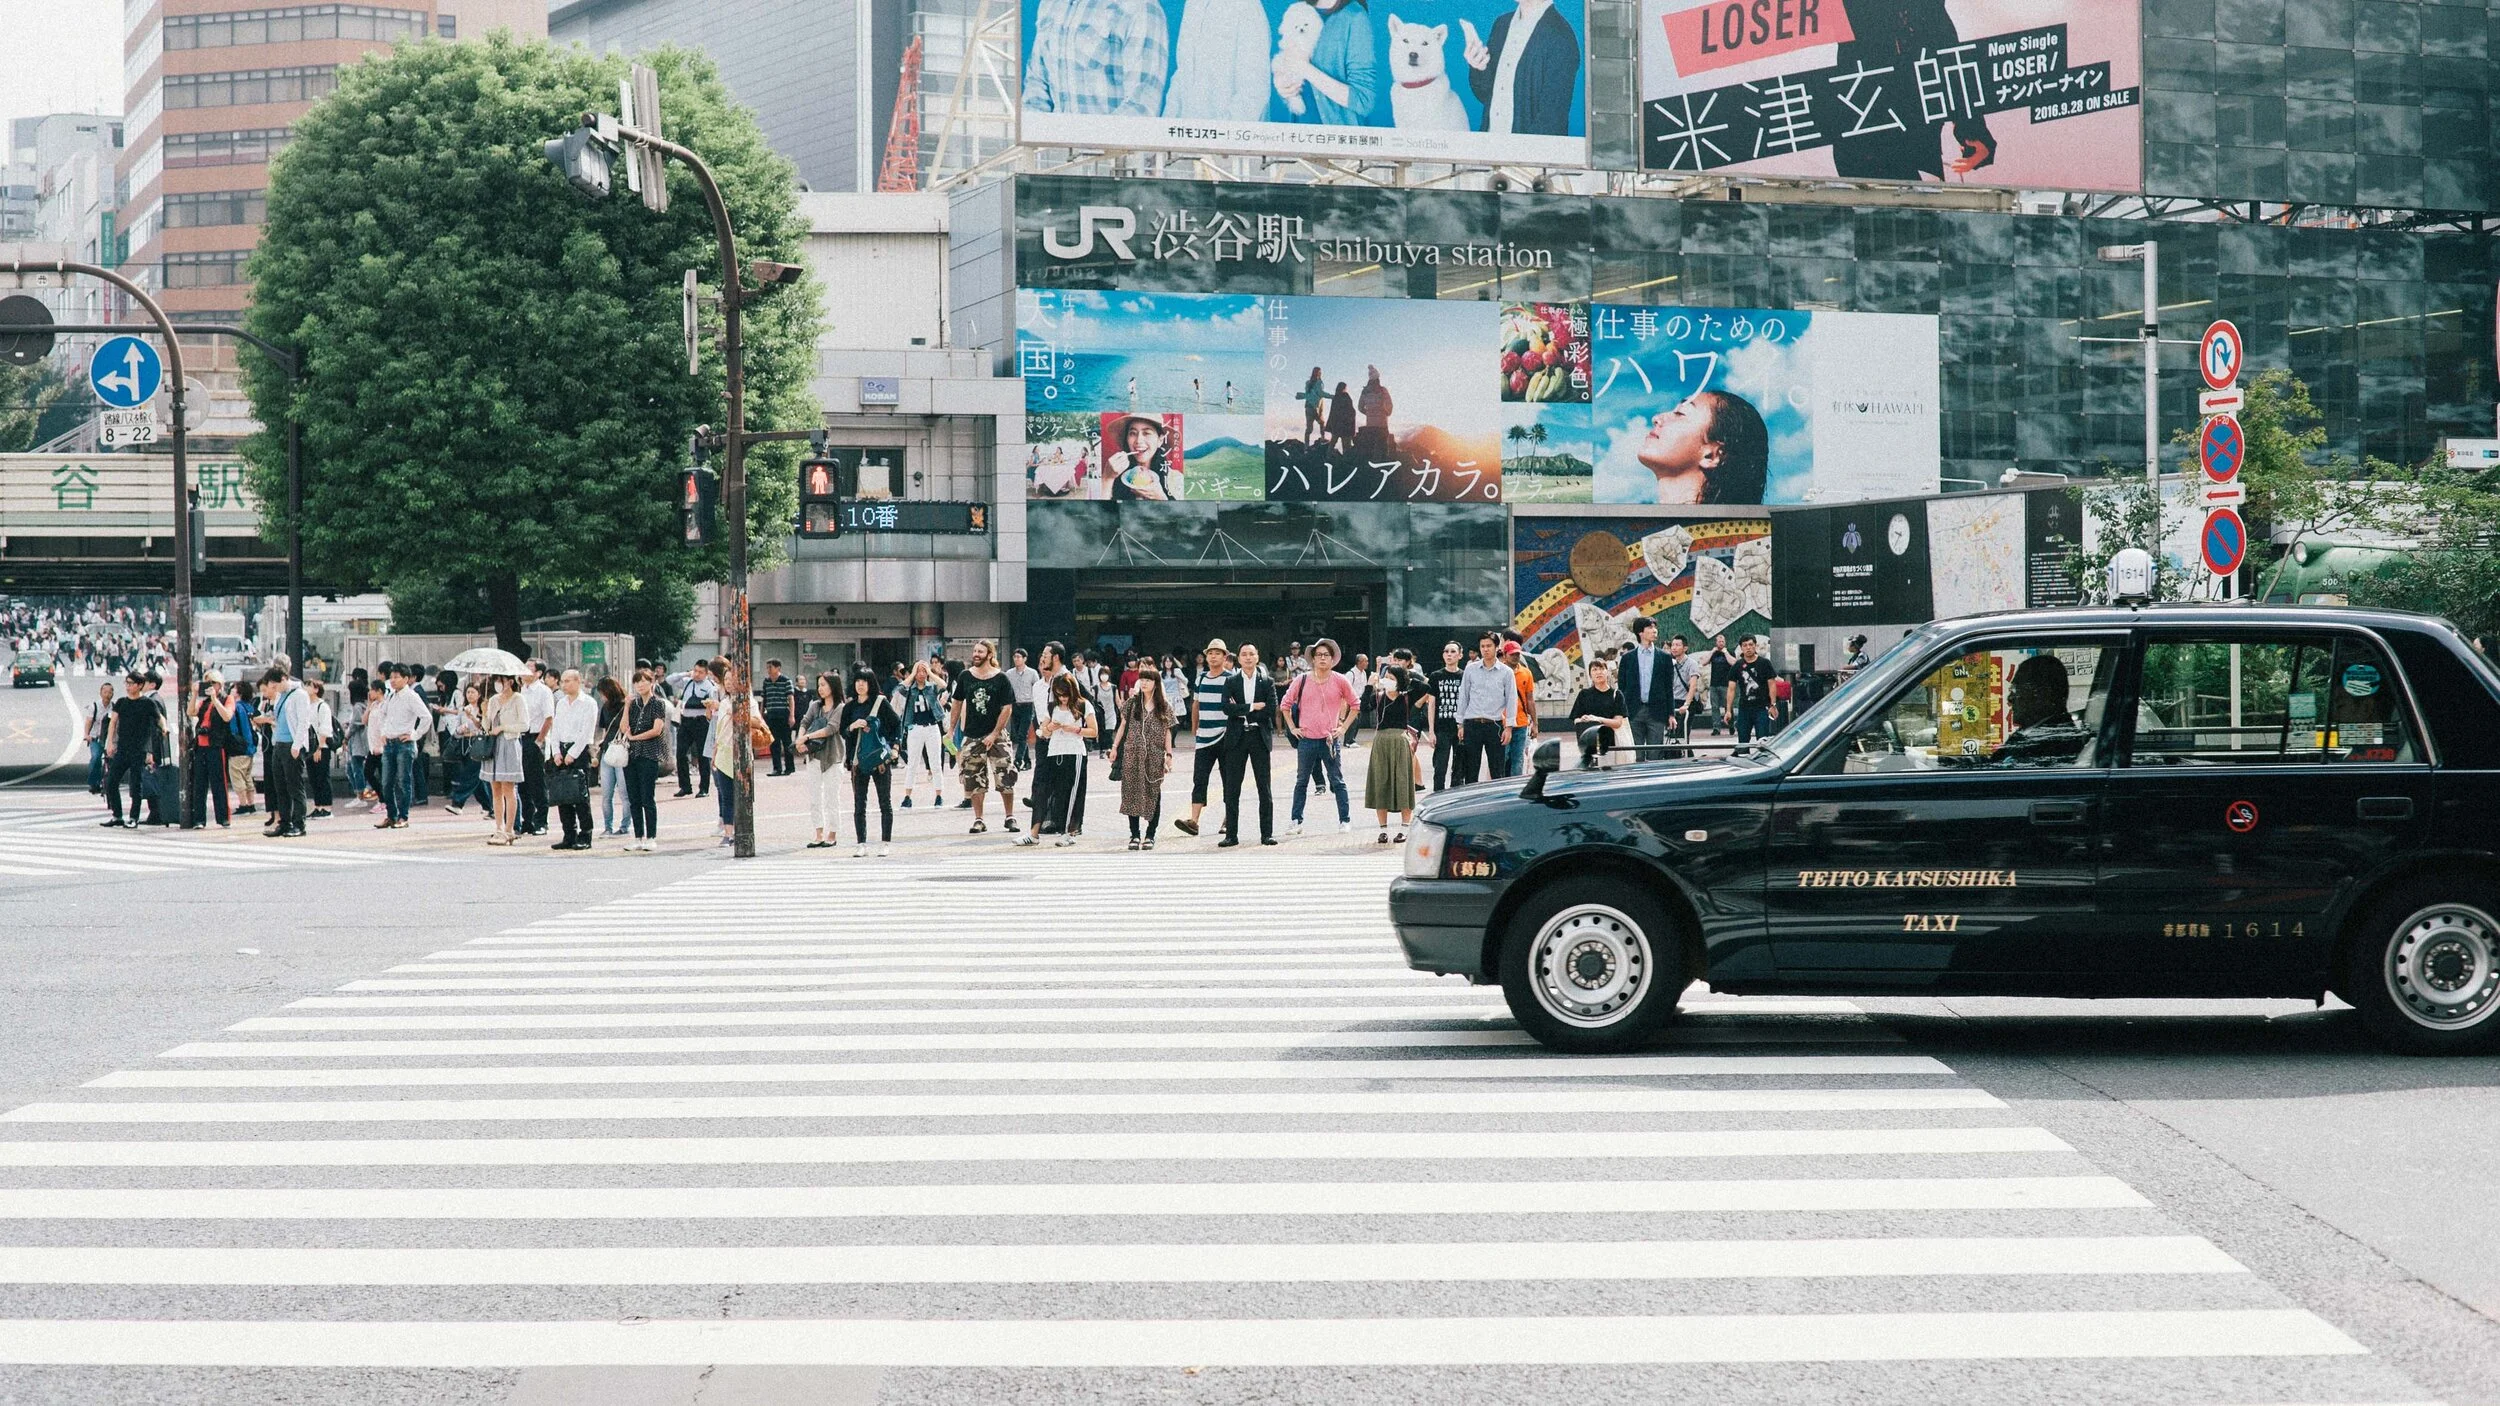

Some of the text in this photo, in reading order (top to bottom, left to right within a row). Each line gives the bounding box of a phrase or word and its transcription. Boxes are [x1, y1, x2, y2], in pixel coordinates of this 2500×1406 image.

[1700, 0, 1819, 55] LOSER
[1988, 32, 2058, 57] New Single
[1996, 69, 2104, 104] ナンバーナイン
[1655, 43, 1985, 171] 米津玄師
[2034, 90, 2130, 121] 2016.9.28 ON SALE
[1043, 206, 1553, 271] JR 渋谷駅 shibuya station
[1595, 308, 1802, 343] 仕事のための、
[1568, 315, 1590, 400] 極彩色。
[864, 392, 897, 400] KOBAN
[1270, 458, 1500, 500] ハレアカラ。
[840, 504, 898, 529] 10番
[2120, 567, 2144, 580] 1614
[2322, 578, 2339, 586] 500
[1798, 870, 2017, 887] TEITO KATSUSHIKA
[1903, 914, 1961, 932] TAXI
[2223, 922, 2305, 938] 1614
